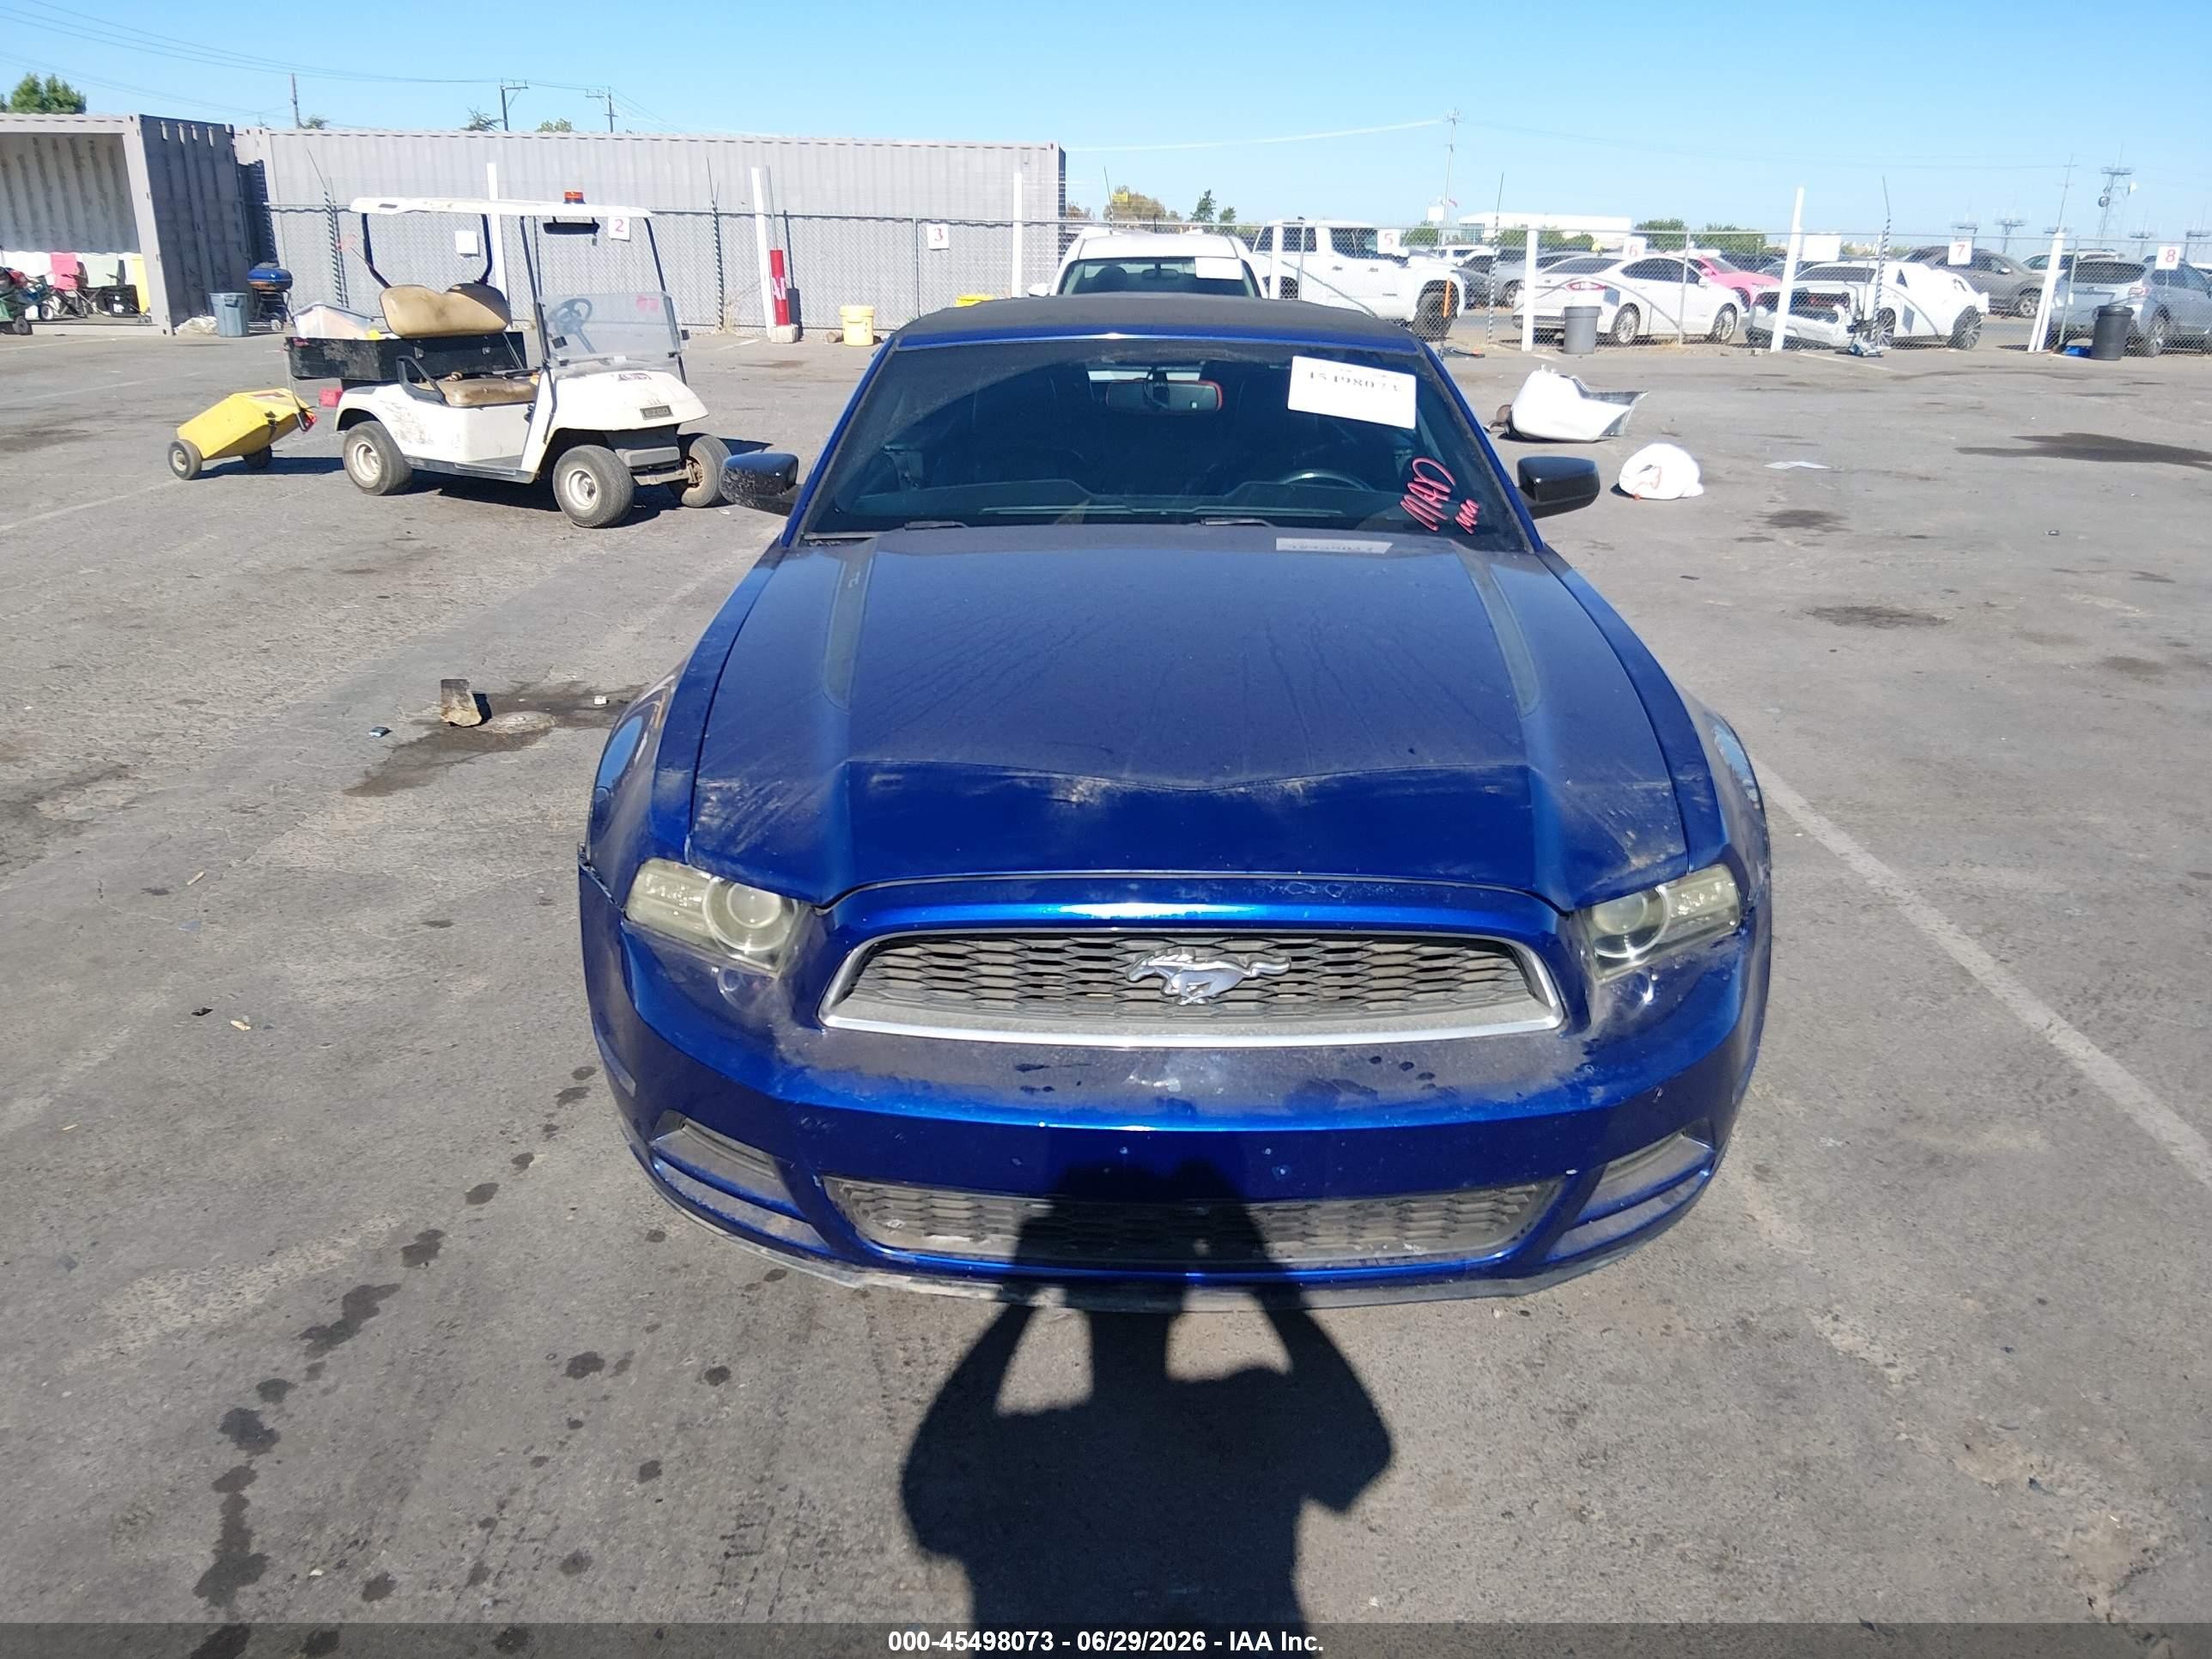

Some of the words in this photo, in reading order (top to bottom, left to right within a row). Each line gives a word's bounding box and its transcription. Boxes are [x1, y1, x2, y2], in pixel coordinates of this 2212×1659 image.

[614, 218, 624, 233] 2
[933, 227, 944, 241] 3
[1383, 233, 1394, 247] 5
[1954, 244, 1966, 258] 7
[2165, 248, 2176, 263] 8
